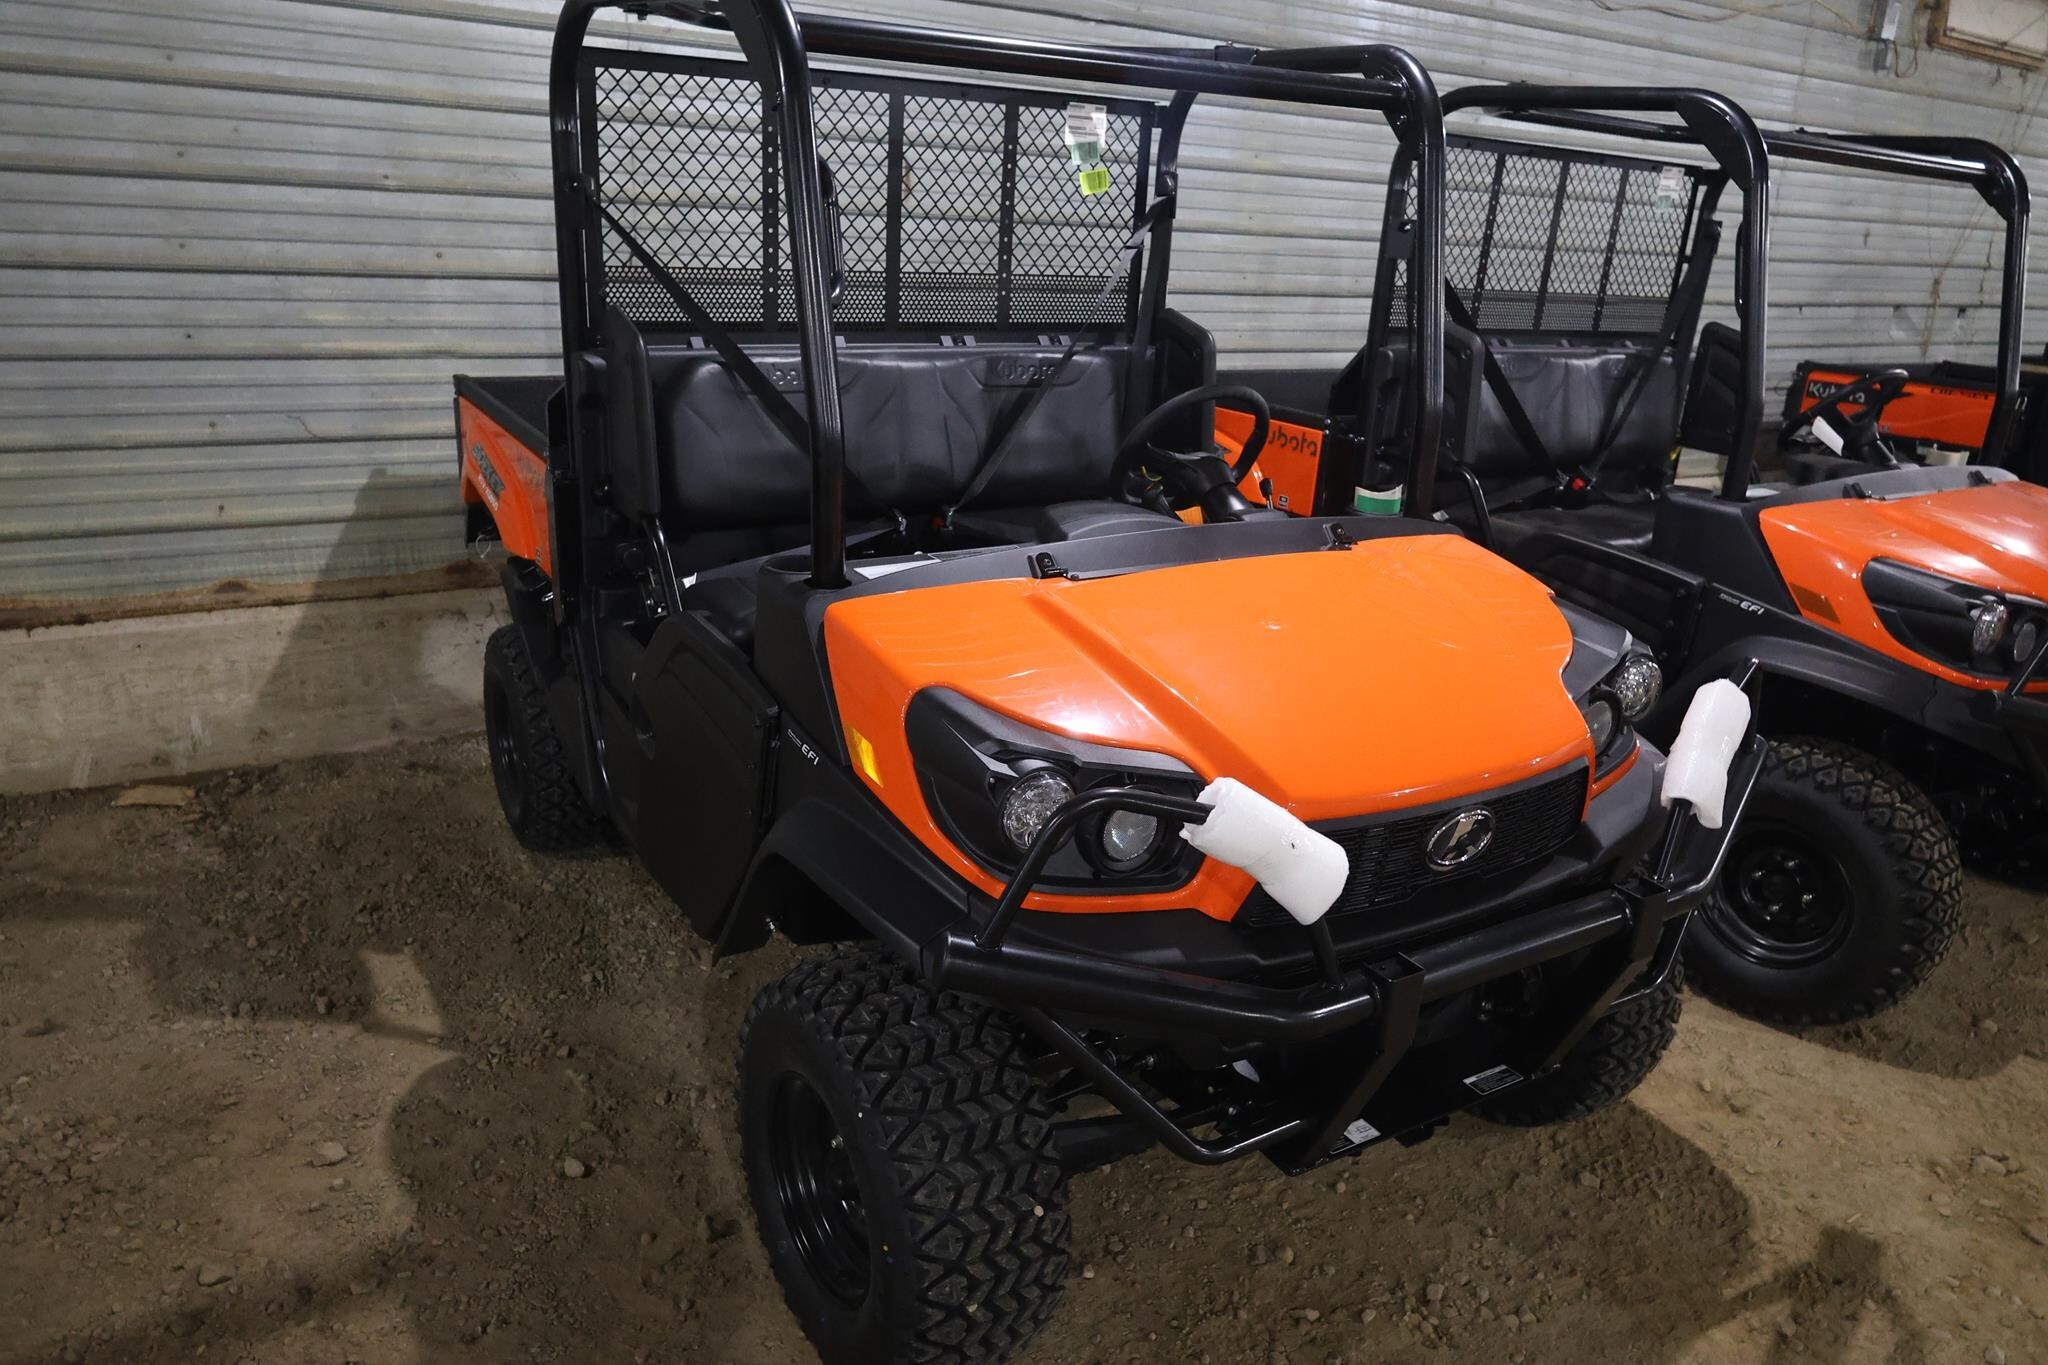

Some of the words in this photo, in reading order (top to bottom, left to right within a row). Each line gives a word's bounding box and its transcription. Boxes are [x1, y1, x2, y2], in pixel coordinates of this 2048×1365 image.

[1268, 426, 1318, 457] ubota
[1740, 600, 1765, 615] EFI
[801, 743, 819, 765] EFI
